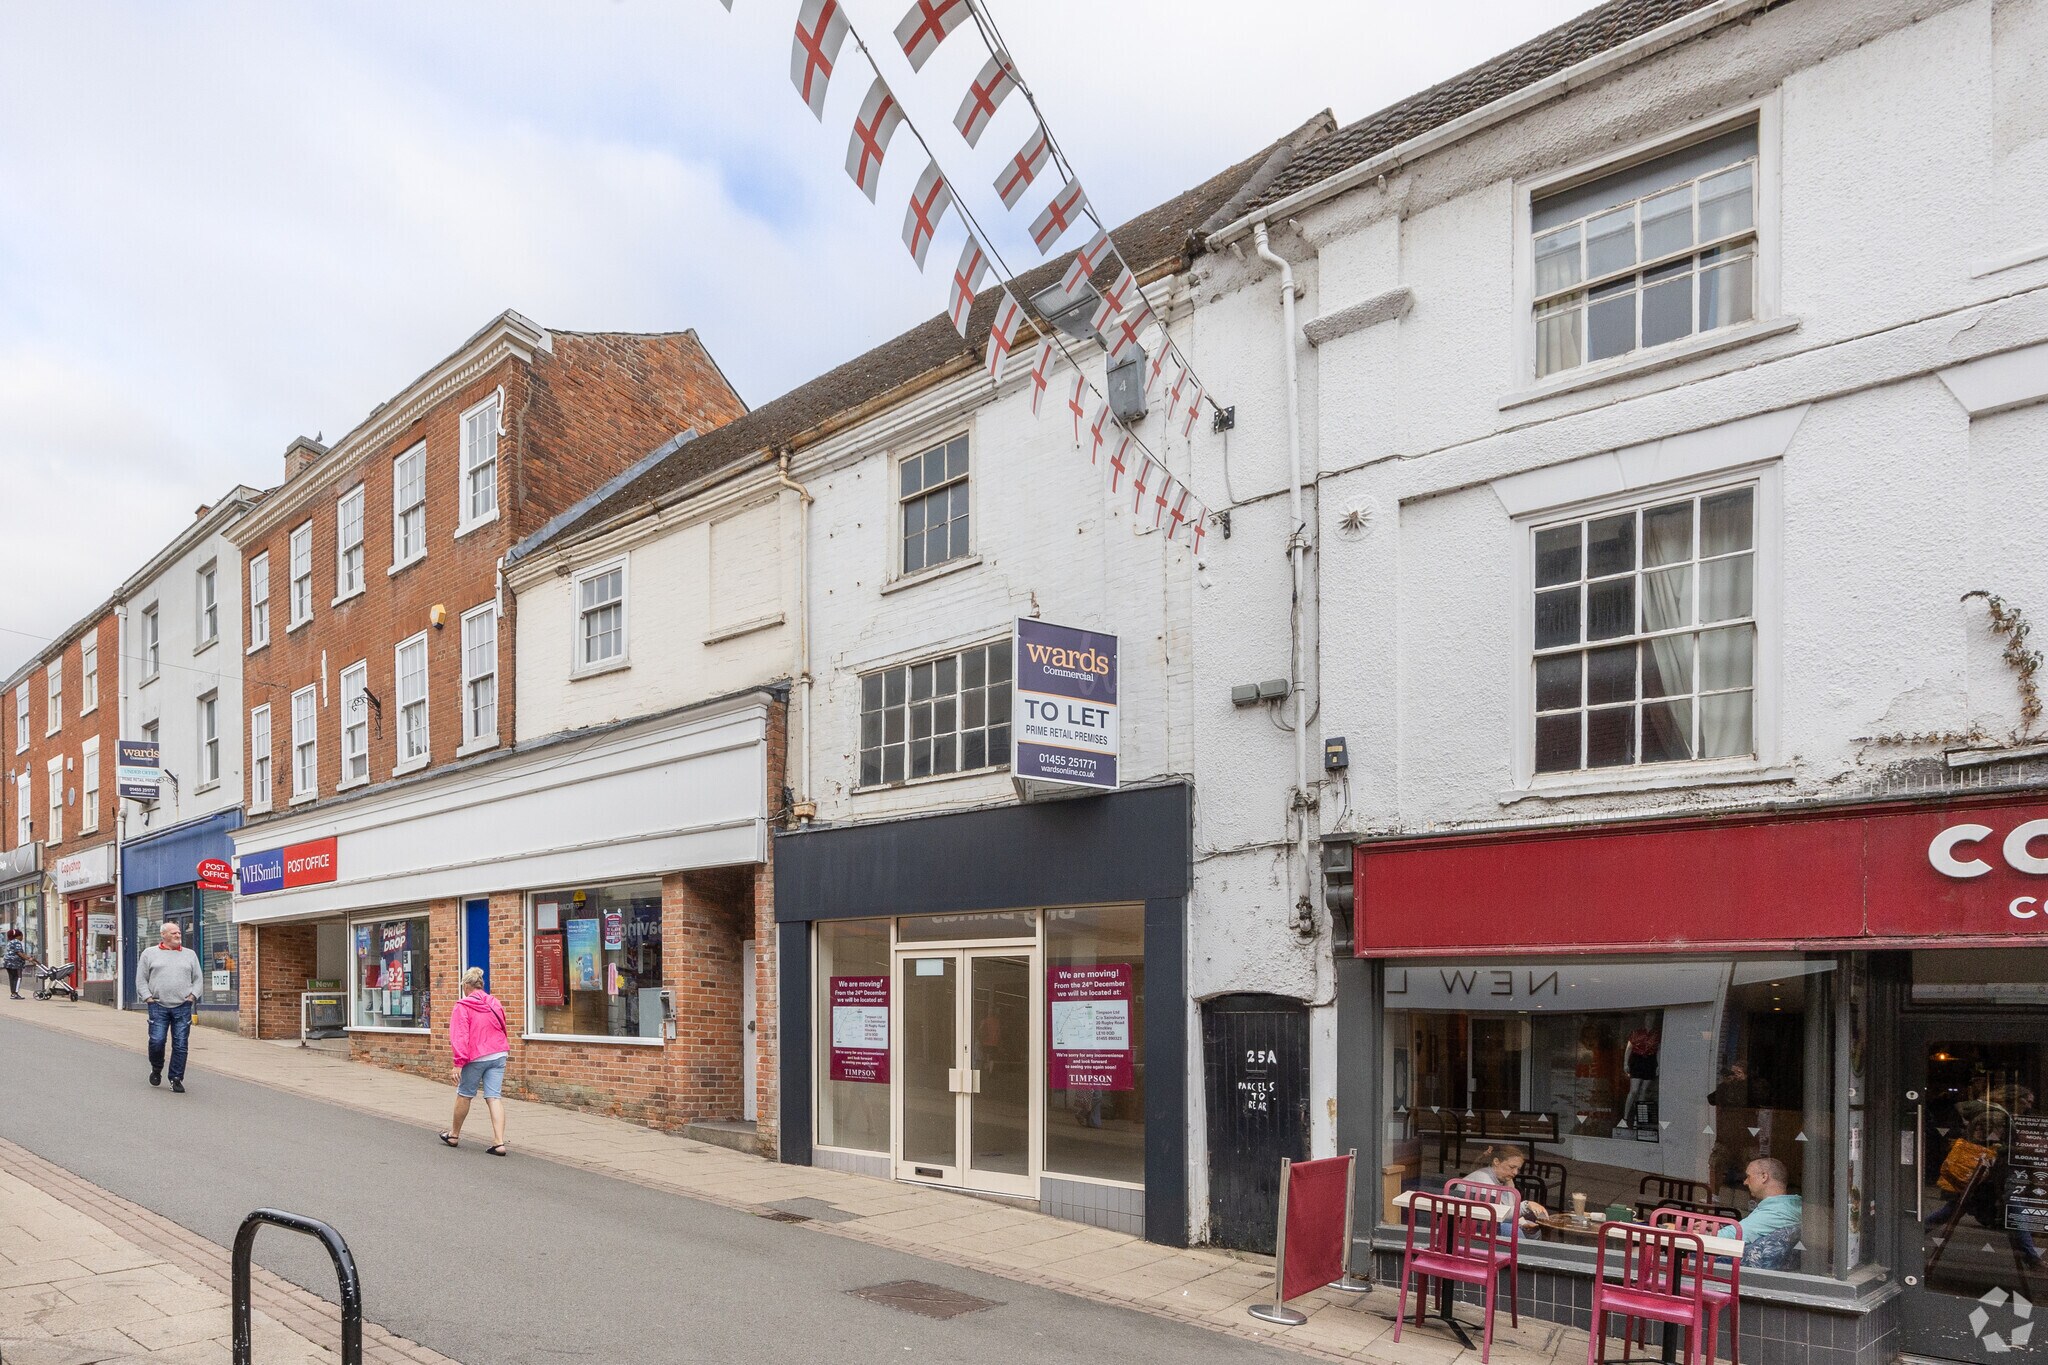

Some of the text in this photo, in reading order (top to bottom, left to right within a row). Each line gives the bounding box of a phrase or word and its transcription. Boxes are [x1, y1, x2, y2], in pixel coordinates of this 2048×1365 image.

[1120, 380, 1126, 391] 4
[1026, 643, 1109, 675] wards
[1043, 665, 1094, 682] Commercial
[1025, 699, 1109, 729] TO LET
[1026, 725, 1108, 746] PRIME RETAIL PREMISES
[123, 748, 160, 758] wards
[1039, 753, 1097, 770] 01455 251771
[1041, 766, 1095, 778] wardsonline.co.uk
[206, 863, 226, 871] POST
[288, 854, 329, 873] POST OFFICE
[202, 870, 229, 880] OFFICE
[242, 861, 282, 884] WHSmith
[2008, 896, 2048, 919] C
[383, 922, 406, 939] PRICE
[384, 936, 406, 952] DROP
[1058, 971, 1071, 979] We
[1087, 969, 1119, 979] moving!
[214, 975, 228, 986] TO LET
[316, 980, 334, 988] New
[859, 979, 884, 988] moving!
[1246, 1050, 1278, 1065] 25A
[844, 1068, 876, 1077] TIMPSON
[1069, 1074, 1112, 1083] TIMPSON
[1238, 1082, 1275, 1092] PARCELS
[1251, 1092, 1266, 1100] TO
[1248, 1100, 1267, 1112] REAR
